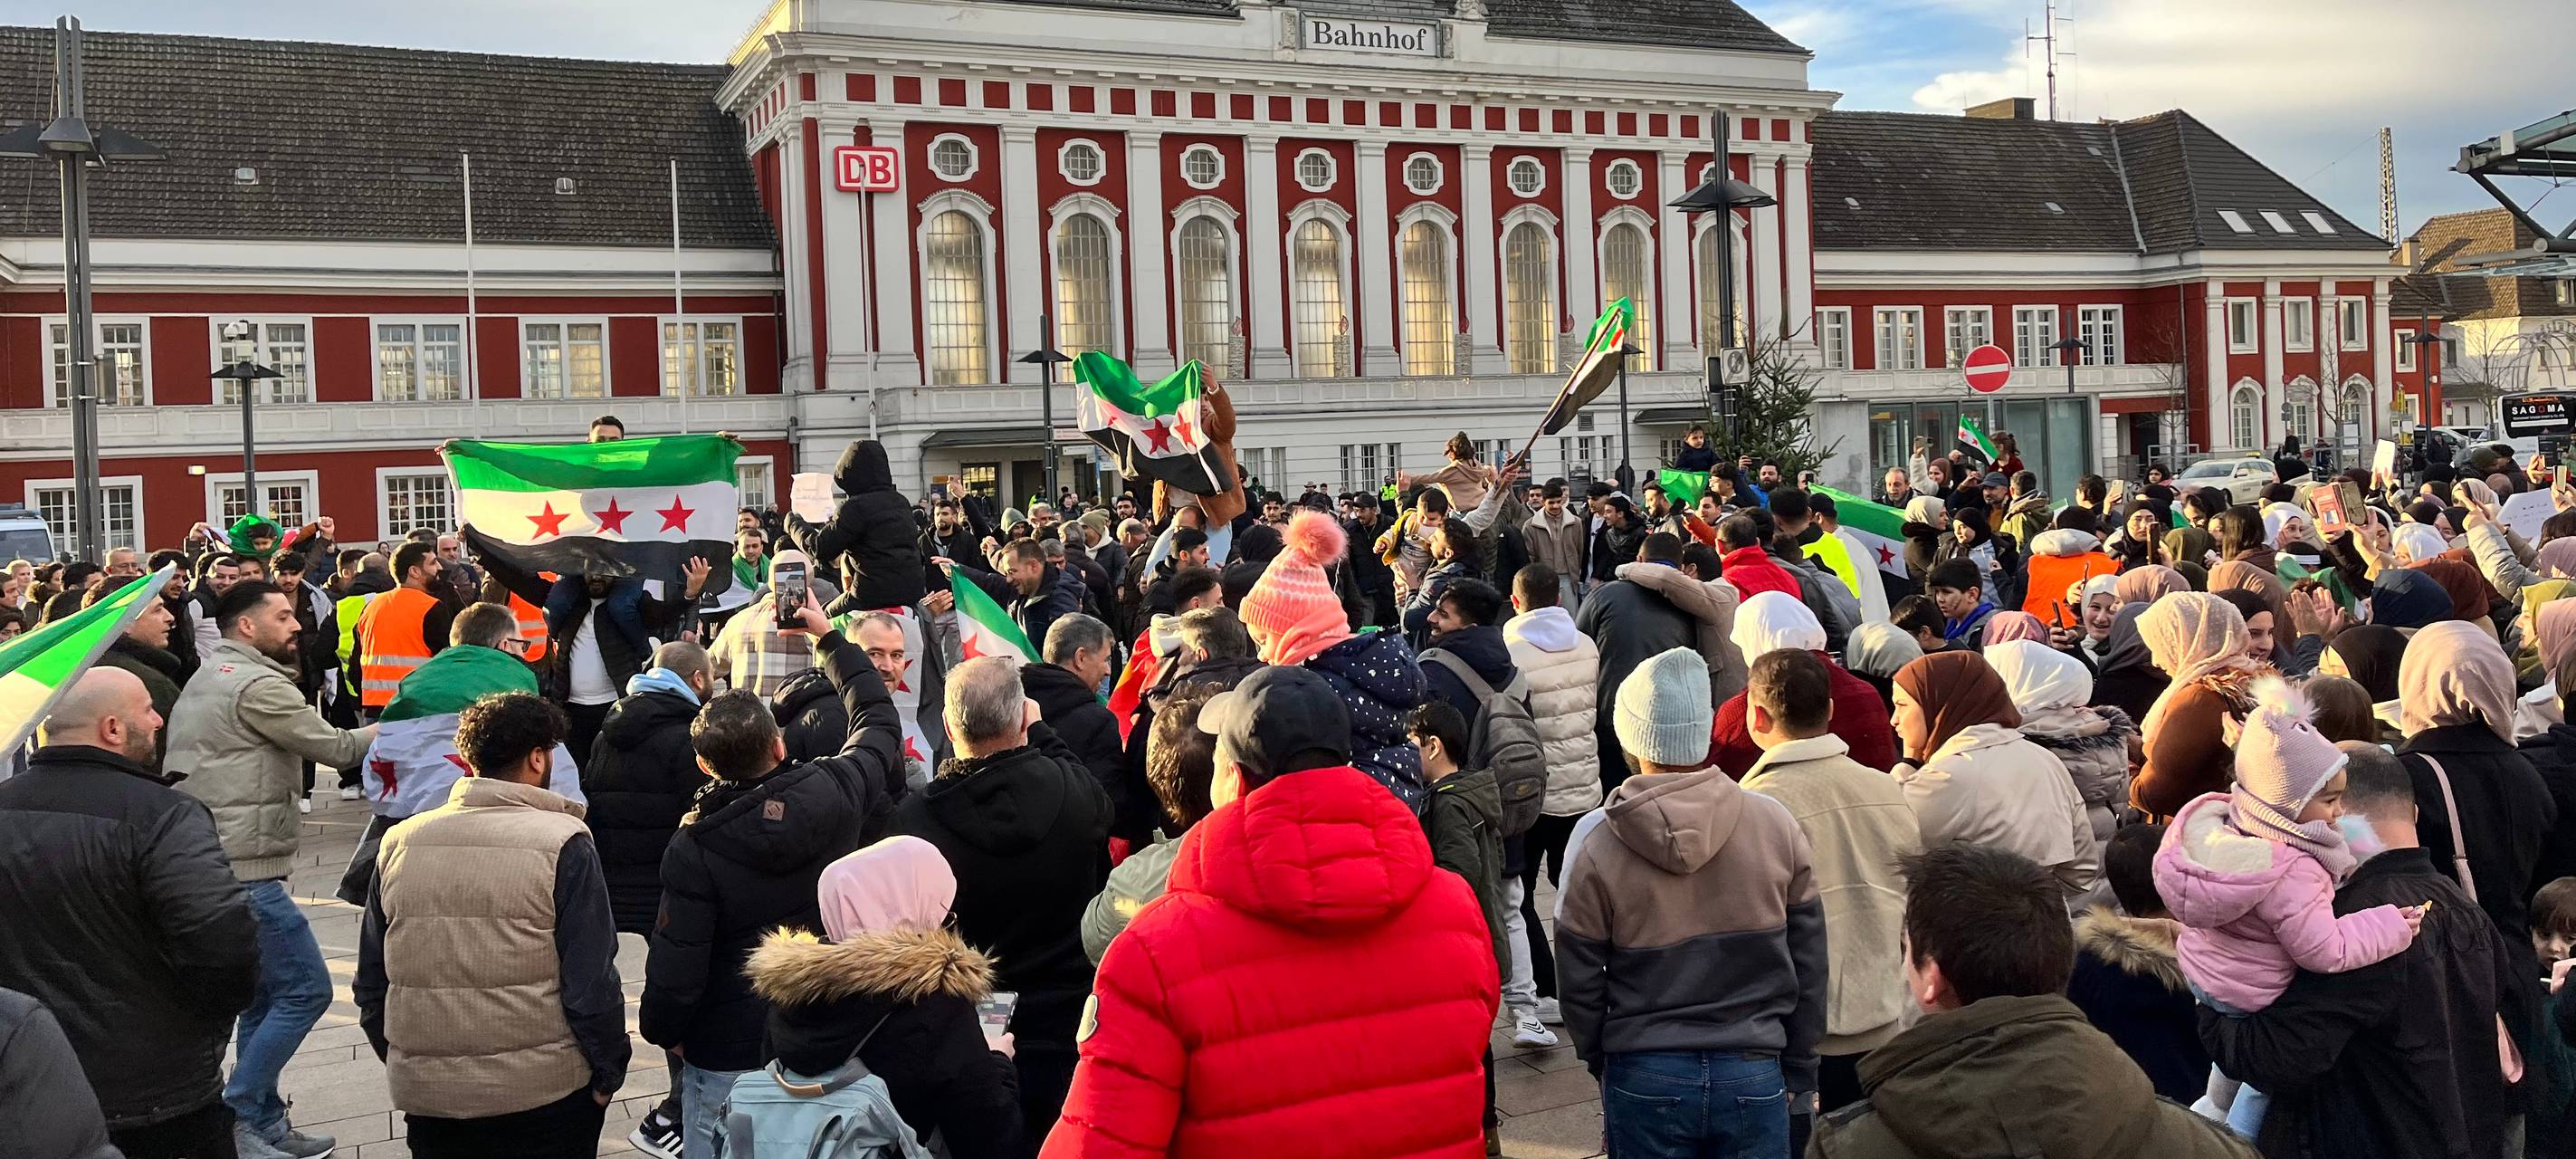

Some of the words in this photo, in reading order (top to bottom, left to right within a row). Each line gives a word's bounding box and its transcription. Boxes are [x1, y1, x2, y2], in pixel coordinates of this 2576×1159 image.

[1312, 20, 1427, 51] Bahnhof
[843, 153, 892, 184] DB
[2512, 404, 2565, 415] SAGOMA
